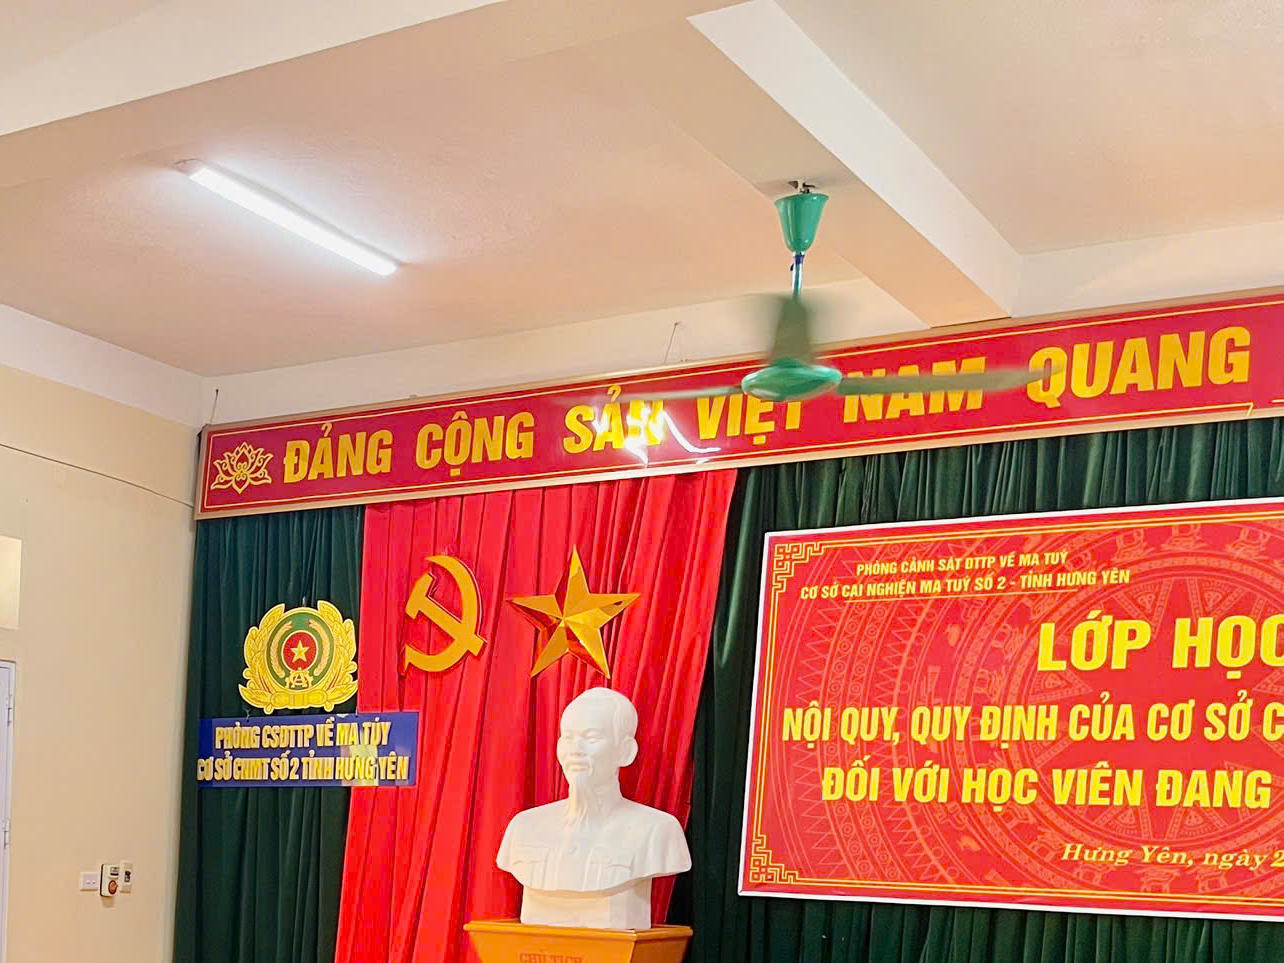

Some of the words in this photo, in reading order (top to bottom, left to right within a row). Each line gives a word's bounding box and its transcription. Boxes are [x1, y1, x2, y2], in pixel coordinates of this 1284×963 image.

[282, 422, 393, 484] ĐẢNG
[416, 410, 535, 476] CỘNG
[843, 356, 987, 424] NAM
[1026, 326, 1251, 408] QUANG
[855, 559, 898, 576] PHÒNG
[900, 555, 935, 574] CẢNH
[937, 555, 963, 571] SÁT
[1018, 553, 1041, 567] MA
[800, 585, 819, 600] CƠ
[820, 581, 839, 599] SỞ
[841, 583, 864, 598] CAI
[866, 578, 917, 599] NGHIỆN
[919, 579, 942, 594] MA
[973, 571, 996, 591] SỐ
[996, 576, 1007, 590] 2
[1019, 569, 1053, 589] TỈNH
[1056, 570, 1098, 587] HƯNG
[1101, 568, 1131, 584] YÊN
[1036, 609, 1153, 672] LỚP
[214, 721, 261, 749] PHÒNG
[336, 722, 359, 747] MA
[781, 700, 832, 749] NỘI
[840, 706, 901, 746] QUY,
[910, 705, 973, 745] QUY
[979, 704, 1059, 749] ĐỊNH
[1068, 690, 1136, 742] CỦA
[1146, 698, 1196, 742] CƠ
[1203, 689, 1254, 742] SỞ
[197, 756, 214, 781] CƠ
[214, 750, 233, 781] SỞ
[270, 750, 291, 781] SỐ
[289, 757, 300, 780] 2
[301, 749, 335, 780] TỈNH
[335, 754, 378, 781] HƯNG
[378, 751, 410, 780] YÊN
[821, 754, 881, 802] ĐỐI
[892, 759, 951, 803] VỚI
[961, 767, 1039, 813] HỌC
[1052, 761, 1144, 808] VIÊN
[1155, 768, 1273, 809] ĐANG
[1060, 843, 1133, 866] Hưng
[1141, 845, 1195, 867] Yên,
[1203, 849, 1268, 871] ngày
